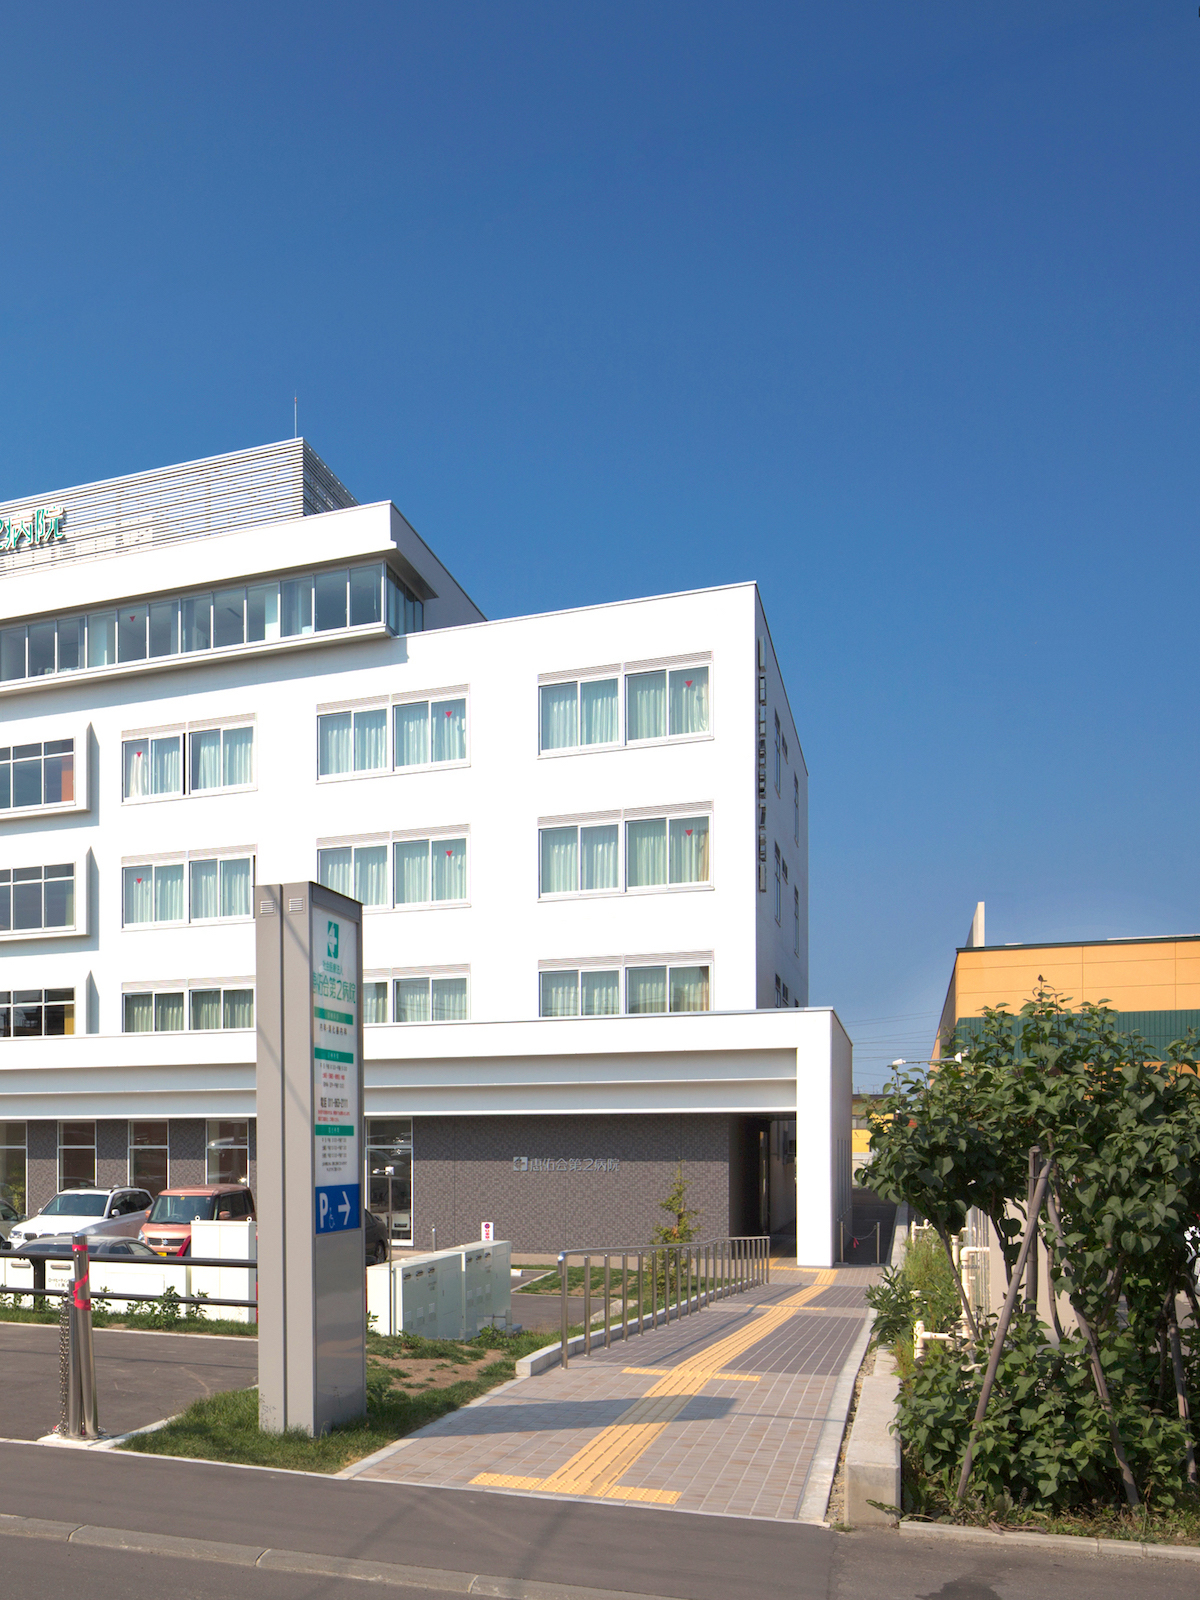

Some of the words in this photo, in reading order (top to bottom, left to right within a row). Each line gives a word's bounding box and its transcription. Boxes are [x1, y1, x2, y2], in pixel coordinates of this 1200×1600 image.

[530, 1158, 620, 1172] 恵佑会第2病院
[319, 1192, 329, 1229] P
